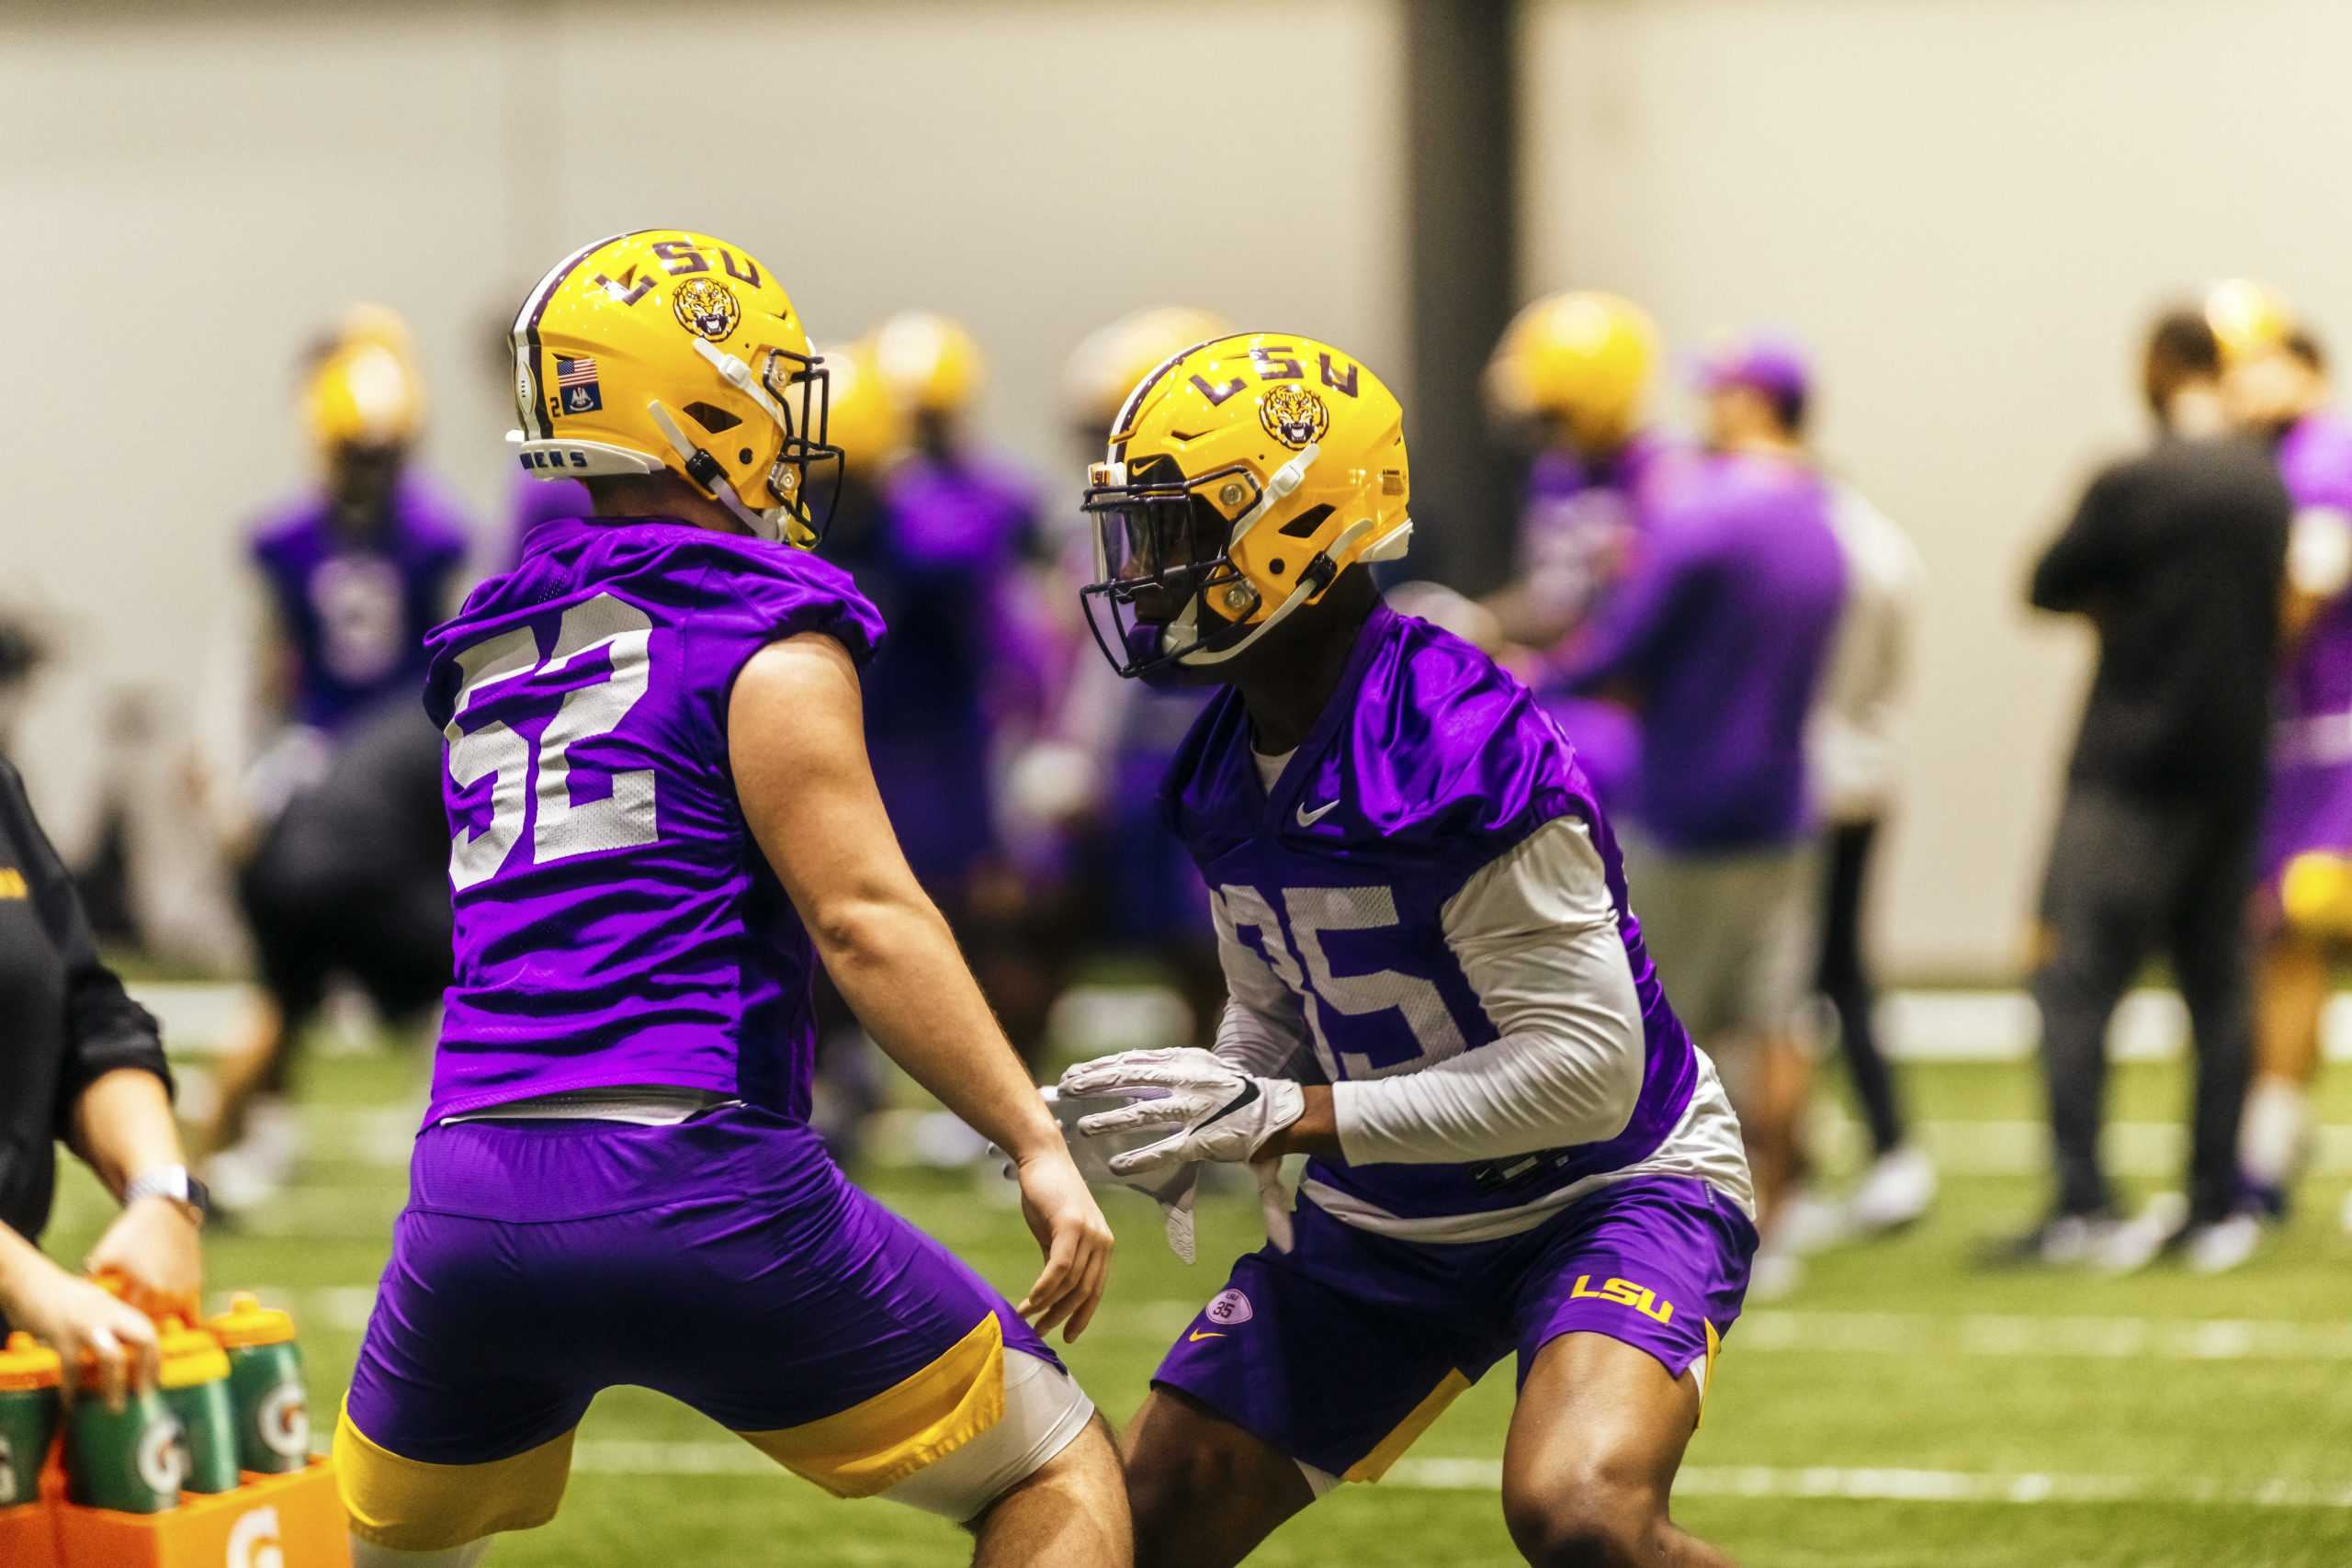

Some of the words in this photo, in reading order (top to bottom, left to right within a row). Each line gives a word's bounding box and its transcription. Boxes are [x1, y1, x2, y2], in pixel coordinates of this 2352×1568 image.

[594, 241, 762, 307] LSU
[1189, 345, 1359, 407] LSU
[443, 591, 659, 893] 52
[1213, 1301, 1236, 1319] 35
[1570, 1274, 1674, 1325] LSU
